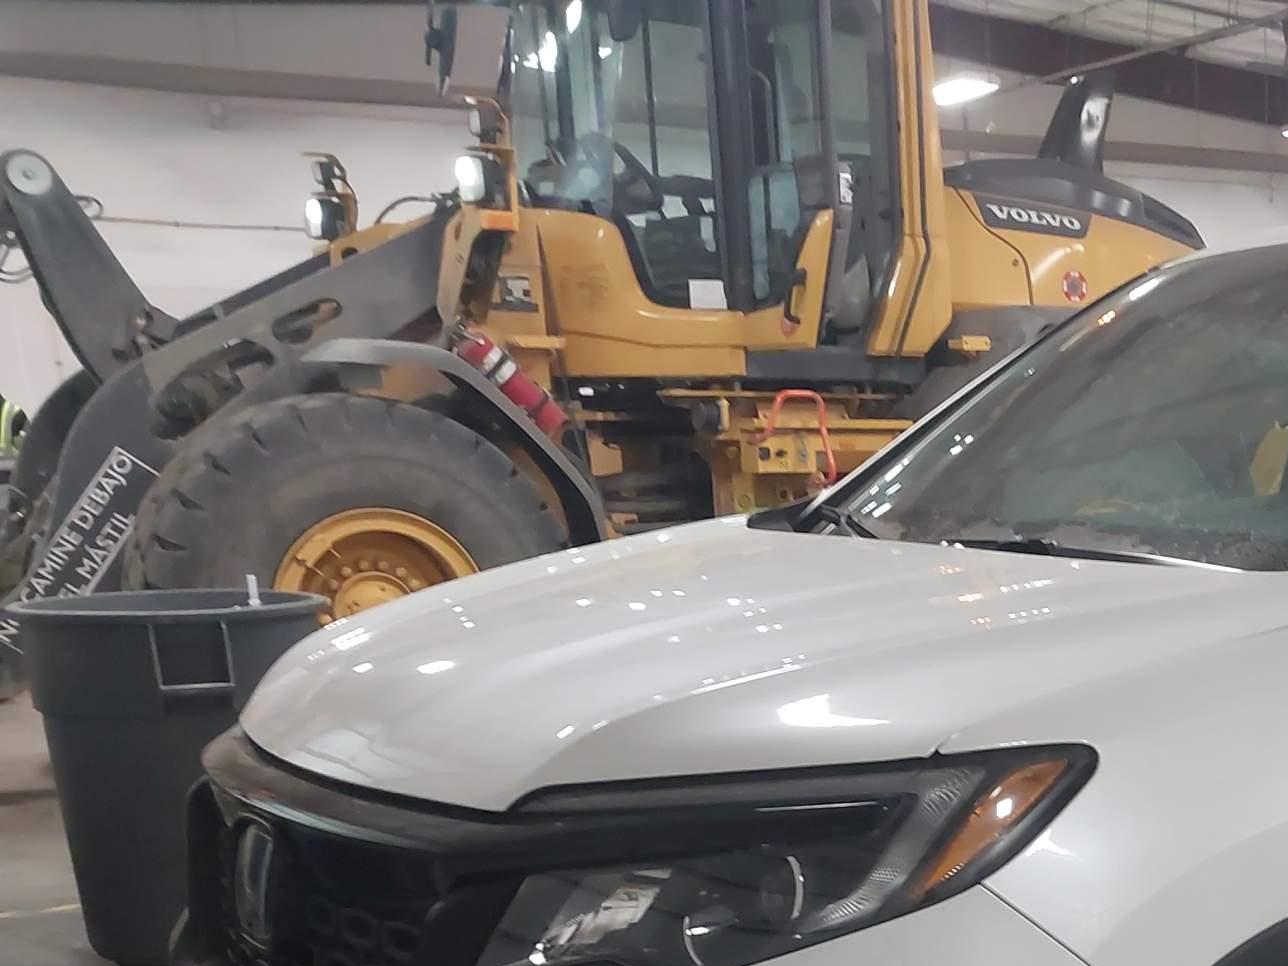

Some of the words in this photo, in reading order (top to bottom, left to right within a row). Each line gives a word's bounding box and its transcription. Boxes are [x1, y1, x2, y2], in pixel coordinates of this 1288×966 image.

[985, 203, 1081, 230] VOLVO
[20, 526, 84, 603] CAMINE
[71, 454, 132, 530] DEBAJO
